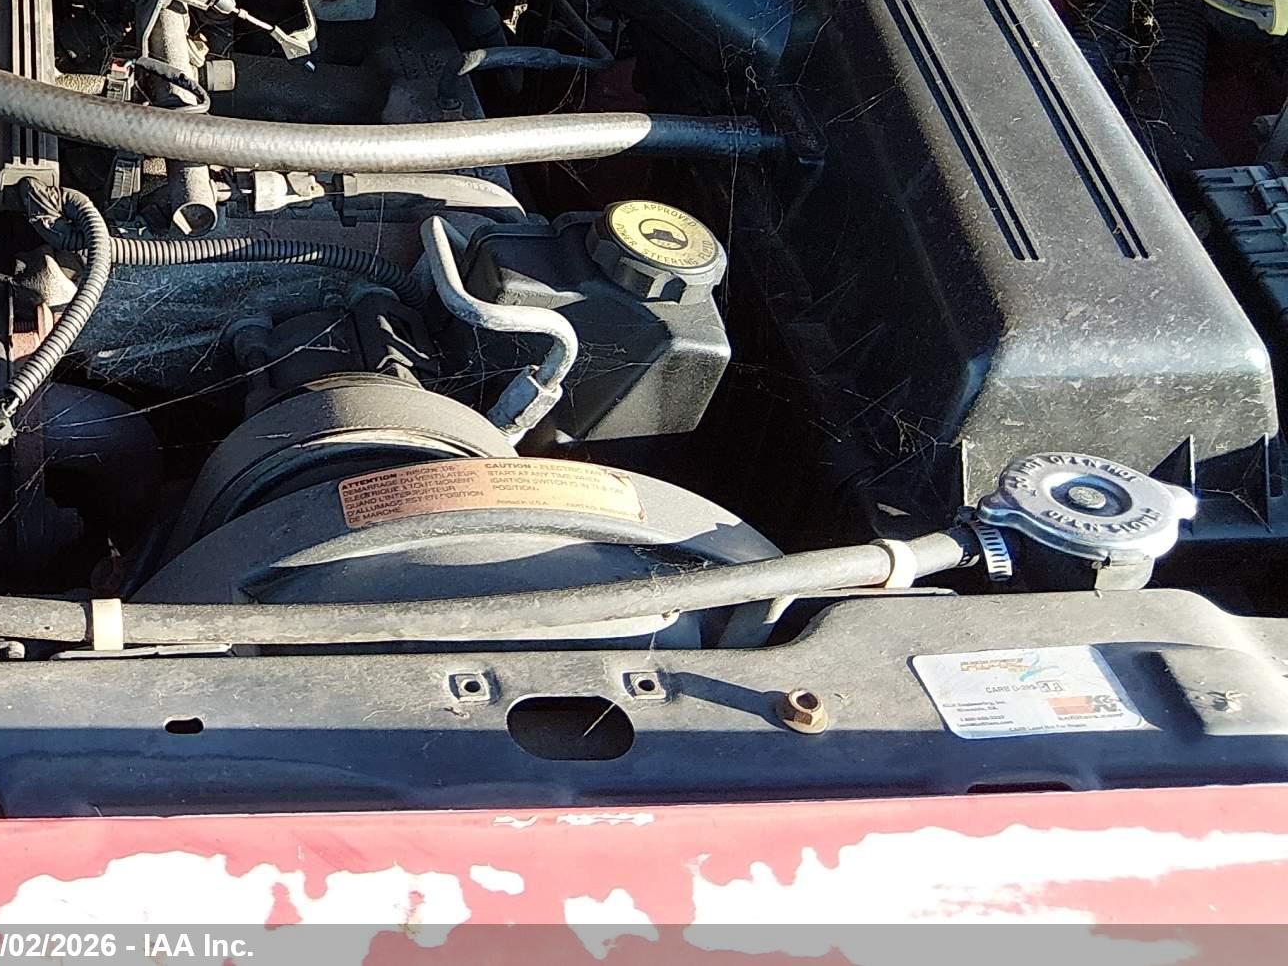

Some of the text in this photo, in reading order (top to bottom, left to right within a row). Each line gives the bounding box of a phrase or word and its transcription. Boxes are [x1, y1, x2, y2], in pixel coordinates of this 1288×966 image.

[644, 203, 697, 227] APPROVED
[643, 248, 699, 266] STEERING
[341, 473, 397, 491] ATTENTION
[343, 481, 398, 497] DEMARRAGE
[346, 499, 377, 510] QUAND
